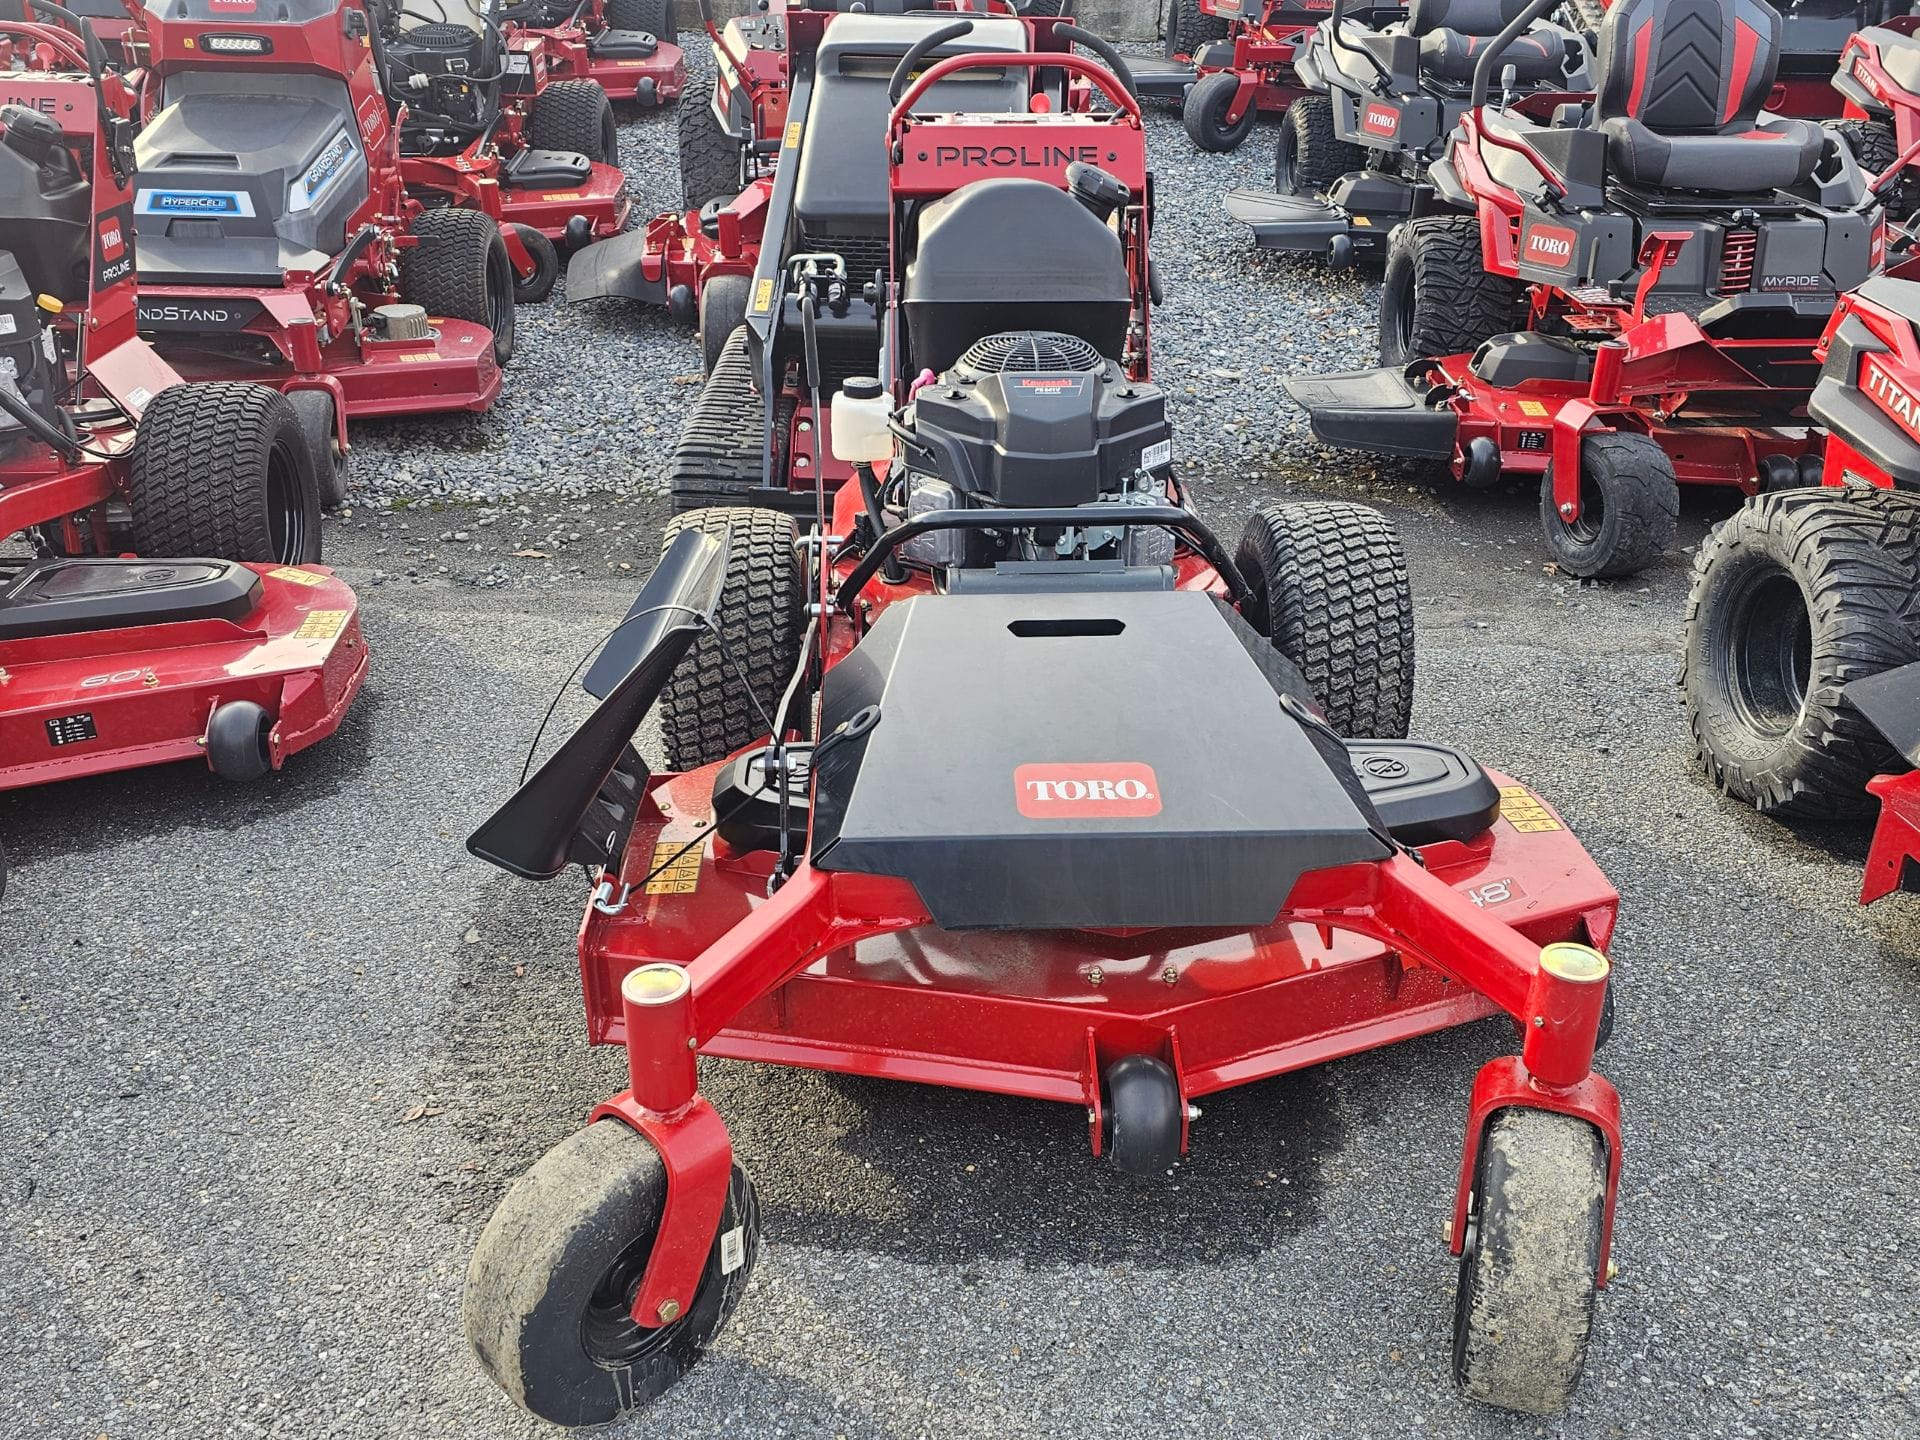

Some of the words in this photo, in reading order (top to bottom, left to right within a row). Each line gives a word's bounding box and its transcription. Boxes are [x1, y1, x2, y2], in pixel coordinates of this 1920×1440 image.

[1856, 63, 1877, 92] TITAN
[1368, 112, 1395, 128] TORO
[937, 146, 1098, 167] PROLINE
[102, 228, 121, 249] TORO
[1531, 235, 1569, 256] TORO
[103, 259, 130, 282] PROLINE
[136, 307, 228, 322] NDSTAND
[1026, 779, 1148, 801] TORO
